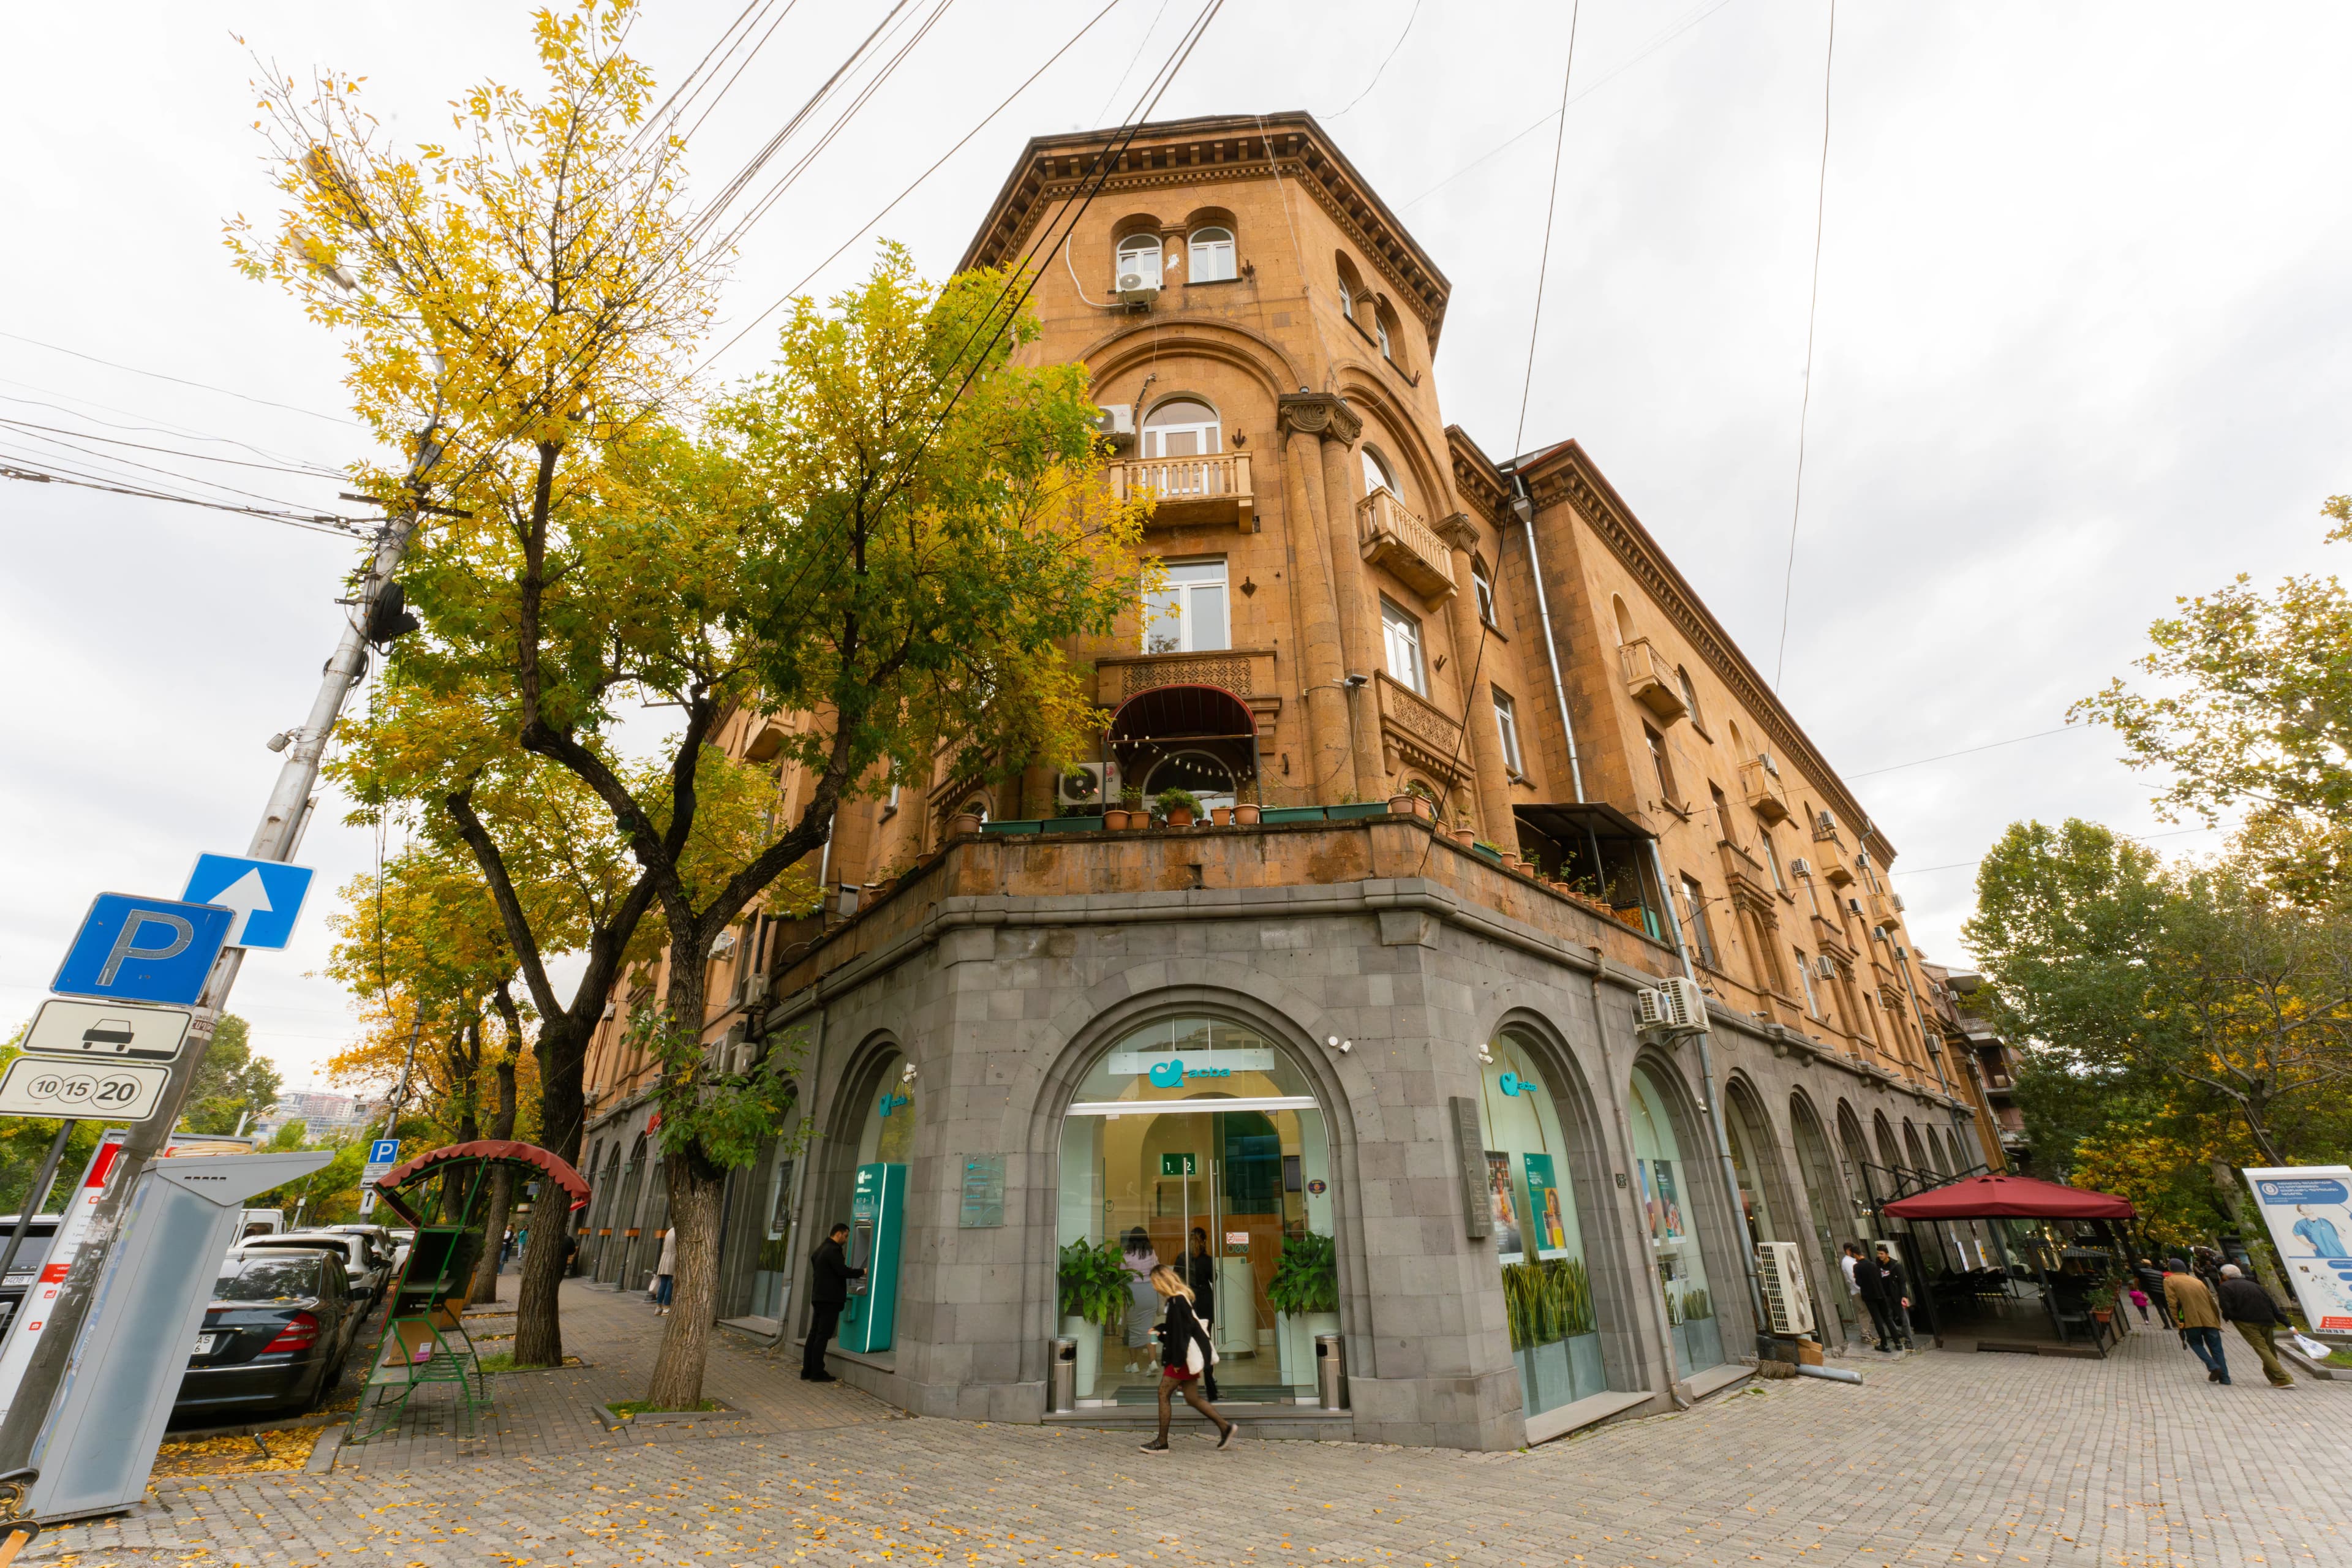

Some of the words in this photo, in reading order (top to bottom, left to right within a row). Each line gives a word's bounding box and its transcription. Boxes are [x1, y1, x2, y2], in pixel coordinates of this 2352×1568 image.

[95, 908, 194, 987] P
[1188, 1066, 1231, 1078] acba
[36, 1080, 58, 1093] 10
[65, 1082, 90, 1096] 15
[96, 1082, 135, 1102] 20
[376, 1143, 393, 1162] P
[1166, 1162, 1170, 1170] 1
[1187, 1162, 1191, 1170] 2
